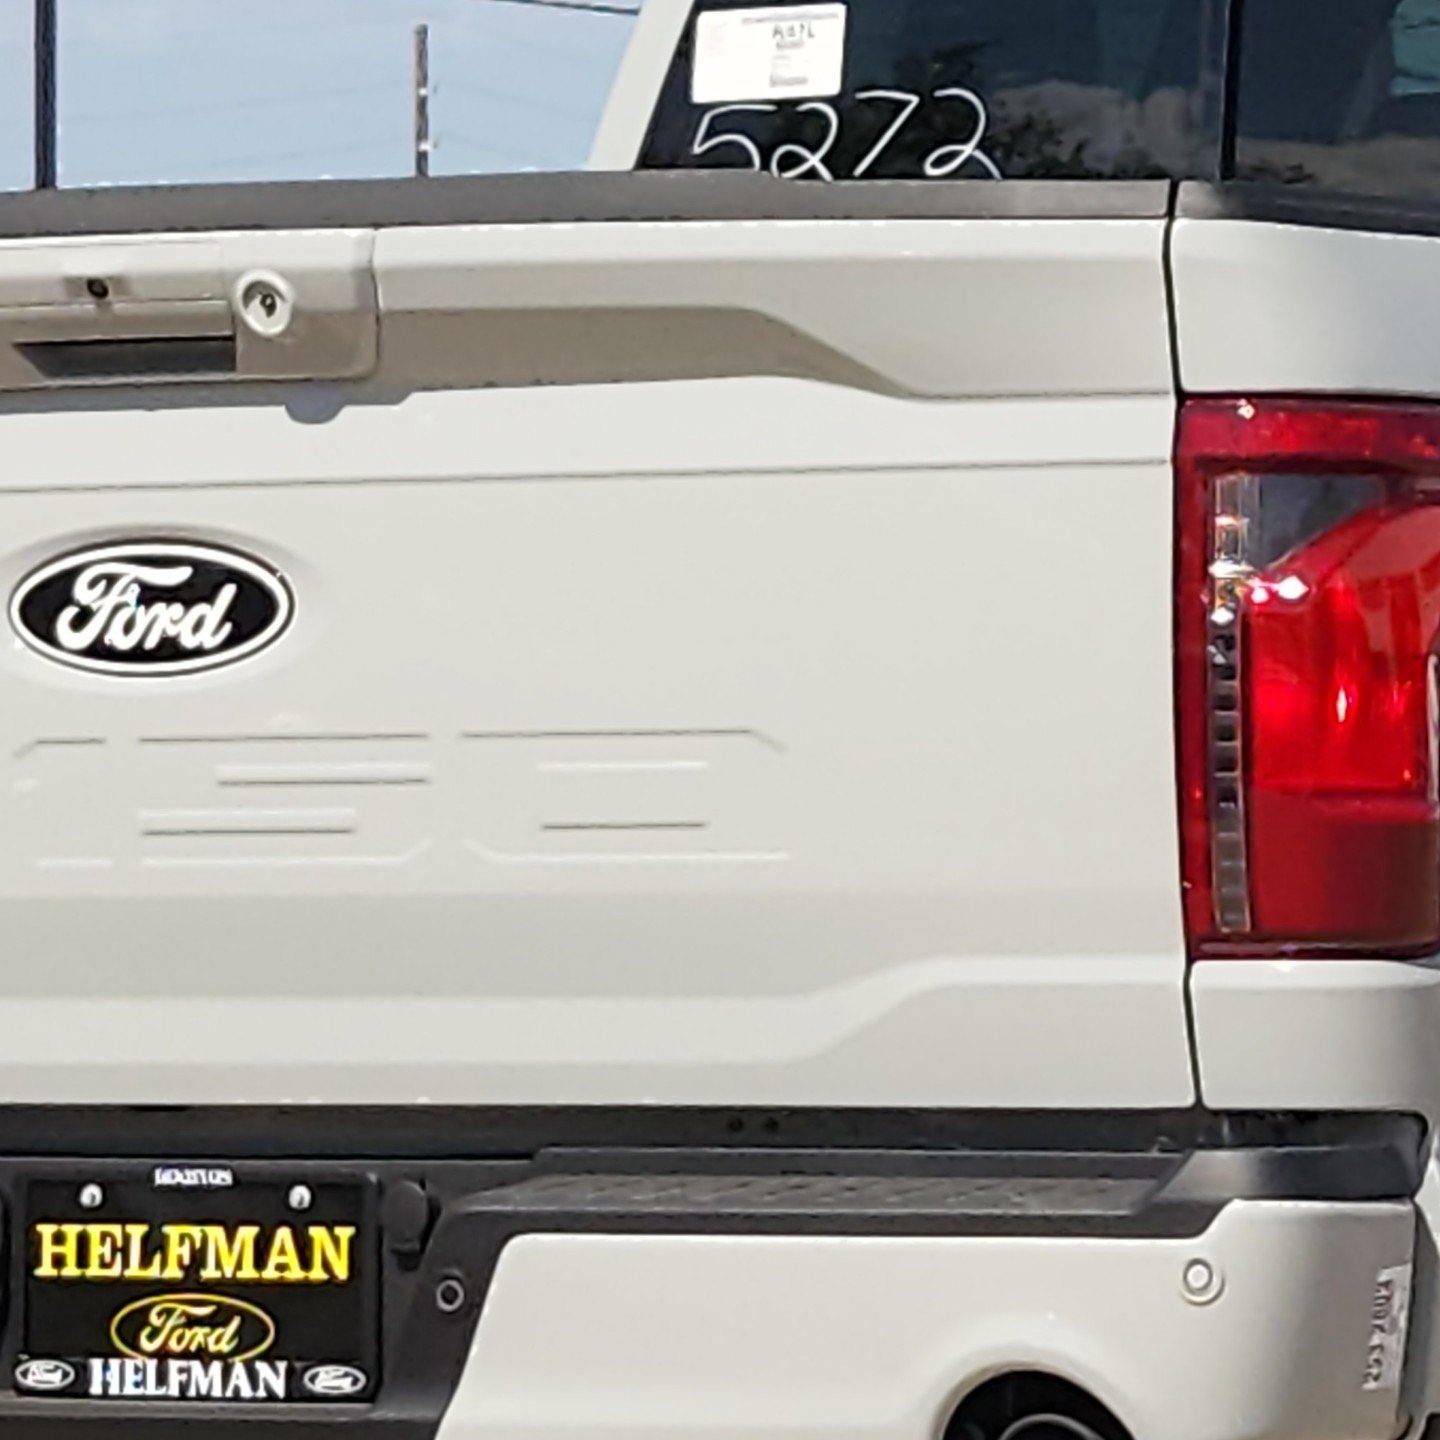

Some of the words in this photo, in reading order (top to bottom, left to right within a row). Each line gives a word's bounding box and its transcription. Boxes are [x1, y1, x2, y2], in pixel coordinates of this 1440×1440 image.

[691, 87, 1003, 182] 5272
[56, 561, 238, 650] Ford
[34, 1223, 356, 1281] HELFMAN
[139, 1302, 241, 1353] Ford
[88, 1358, 288, 1399] HELFMAN
